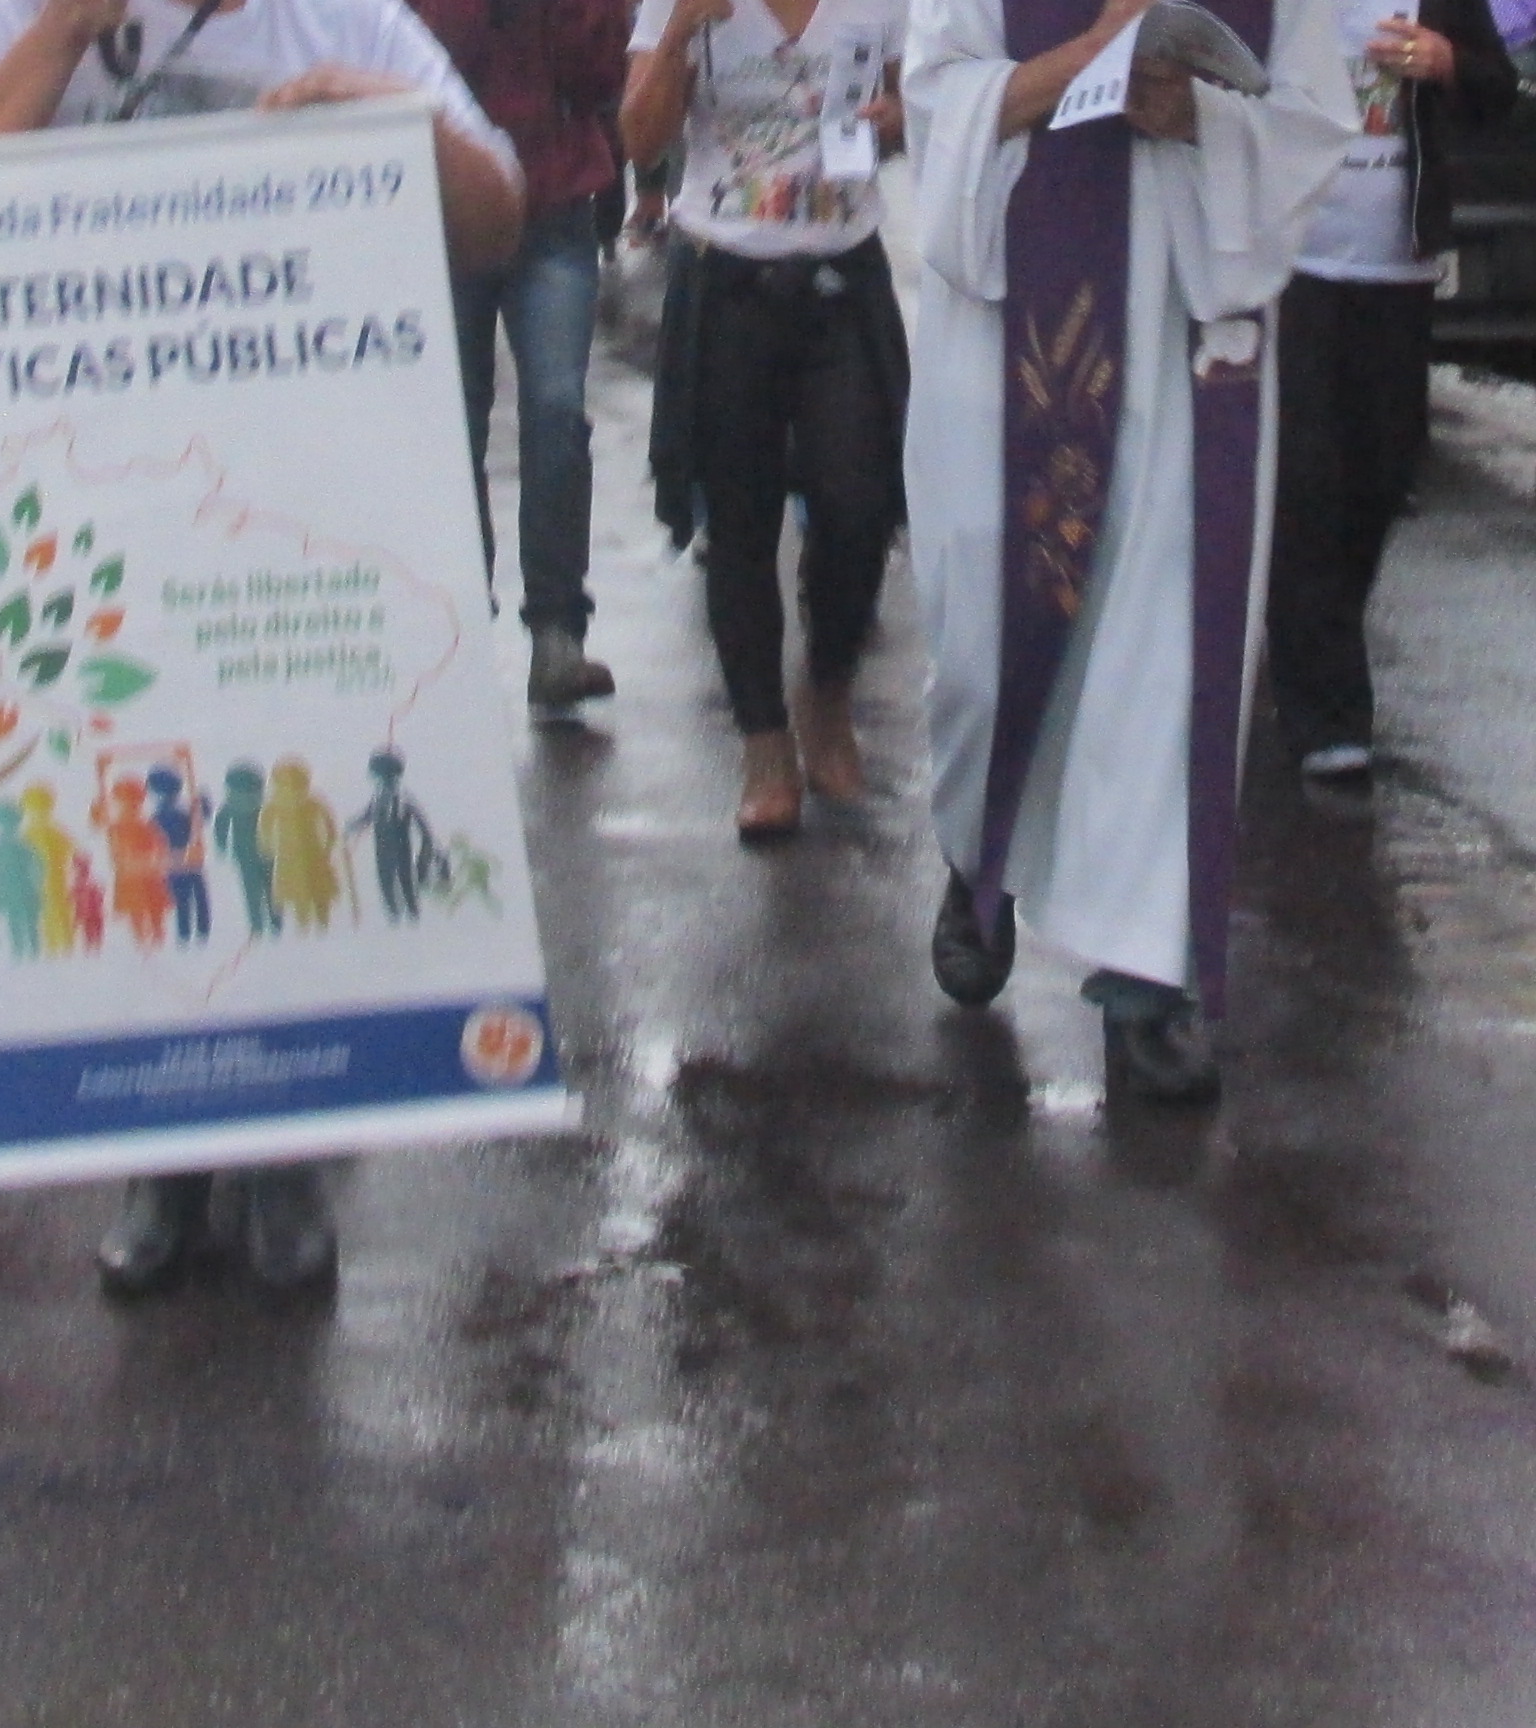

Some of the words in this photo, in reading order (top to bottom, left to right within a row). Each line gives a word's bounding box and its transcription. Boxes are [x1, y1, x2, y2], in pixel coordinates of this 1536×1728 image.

[49, 172, 297, 238] Fraternidade
[306, 159, 404, 212] 2019
[147, 307, 427, 388] PÚBLICAS
